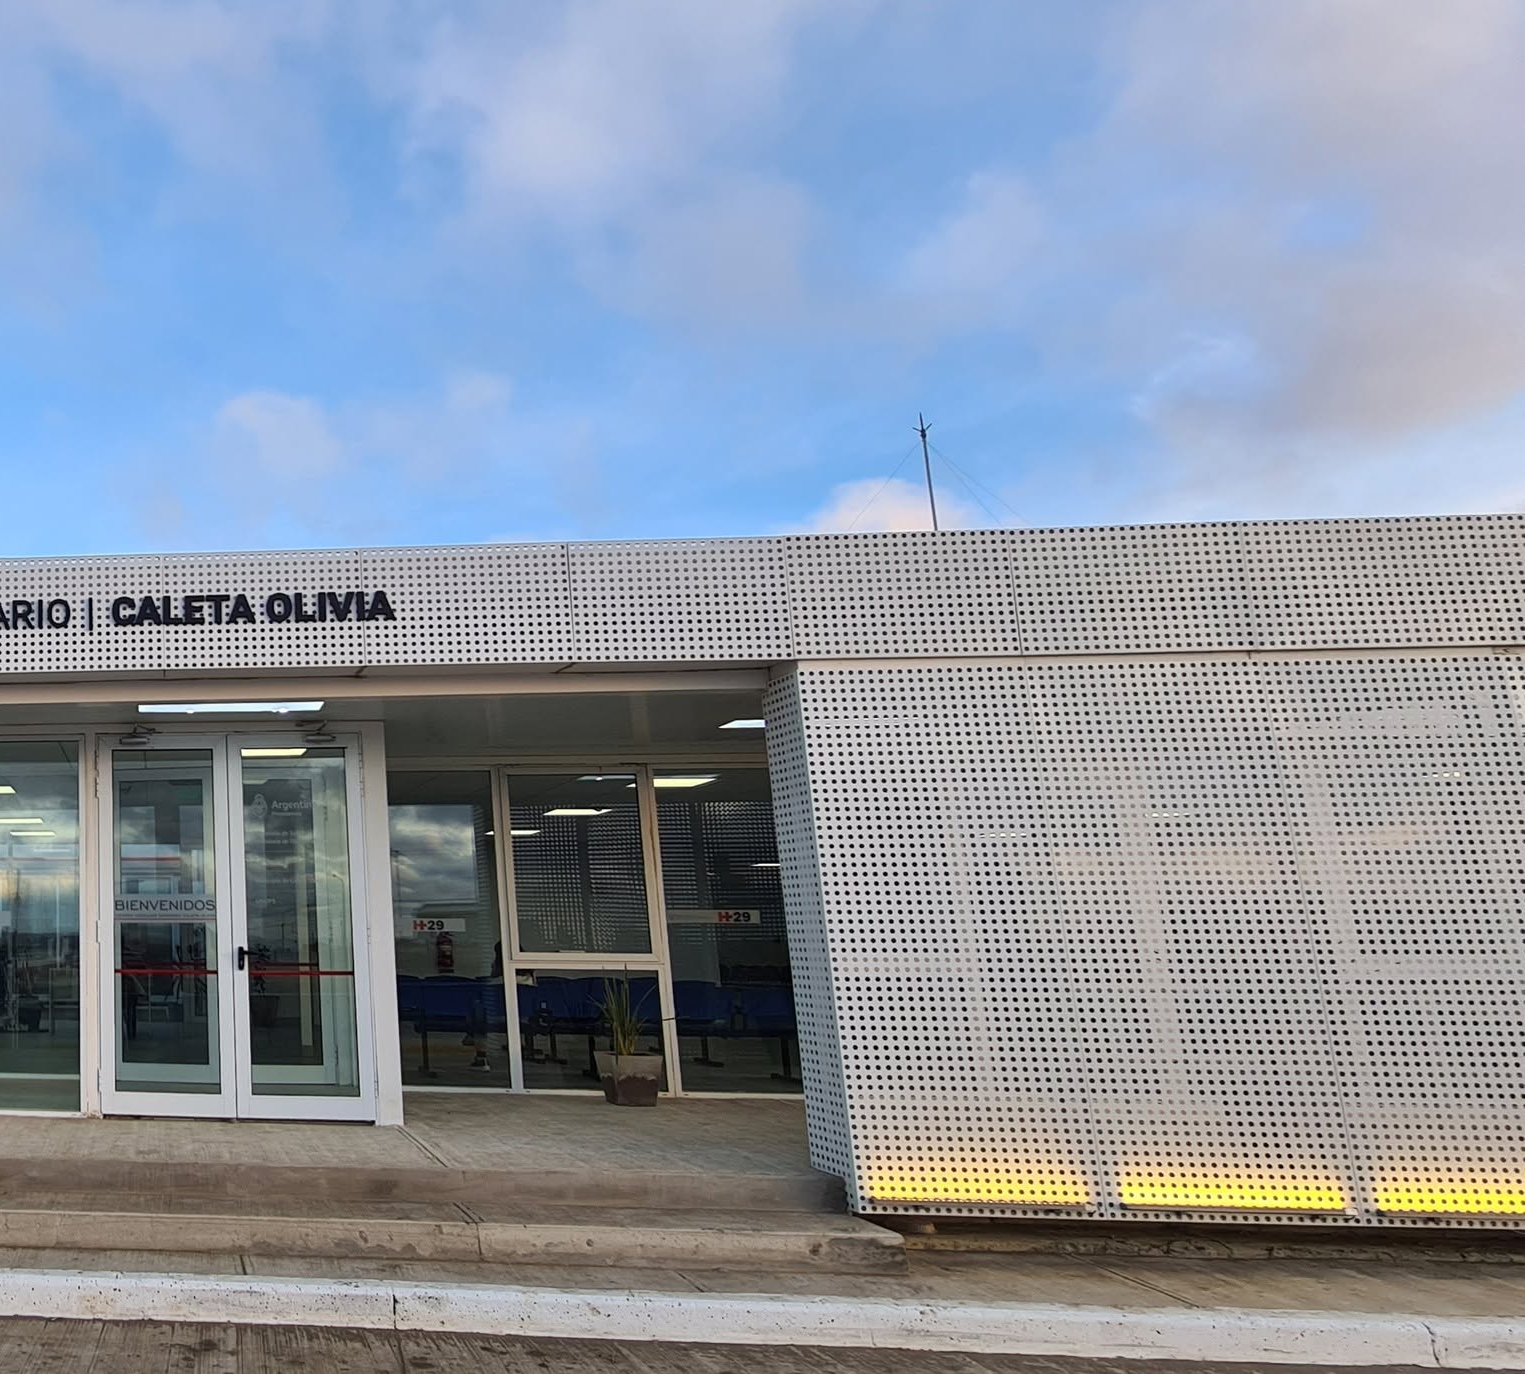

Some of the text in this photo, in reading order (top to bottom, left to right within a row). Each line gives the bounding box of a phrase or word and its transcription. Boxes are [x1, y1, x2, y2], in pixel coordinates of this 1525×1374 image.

[112, 594, 256, 627] CALETA
[266, 590, 397, 622] OLIVIA
[271, 801, 316, 811] Argentin
[114, 899, 216, 912] BIENVENIDOS
